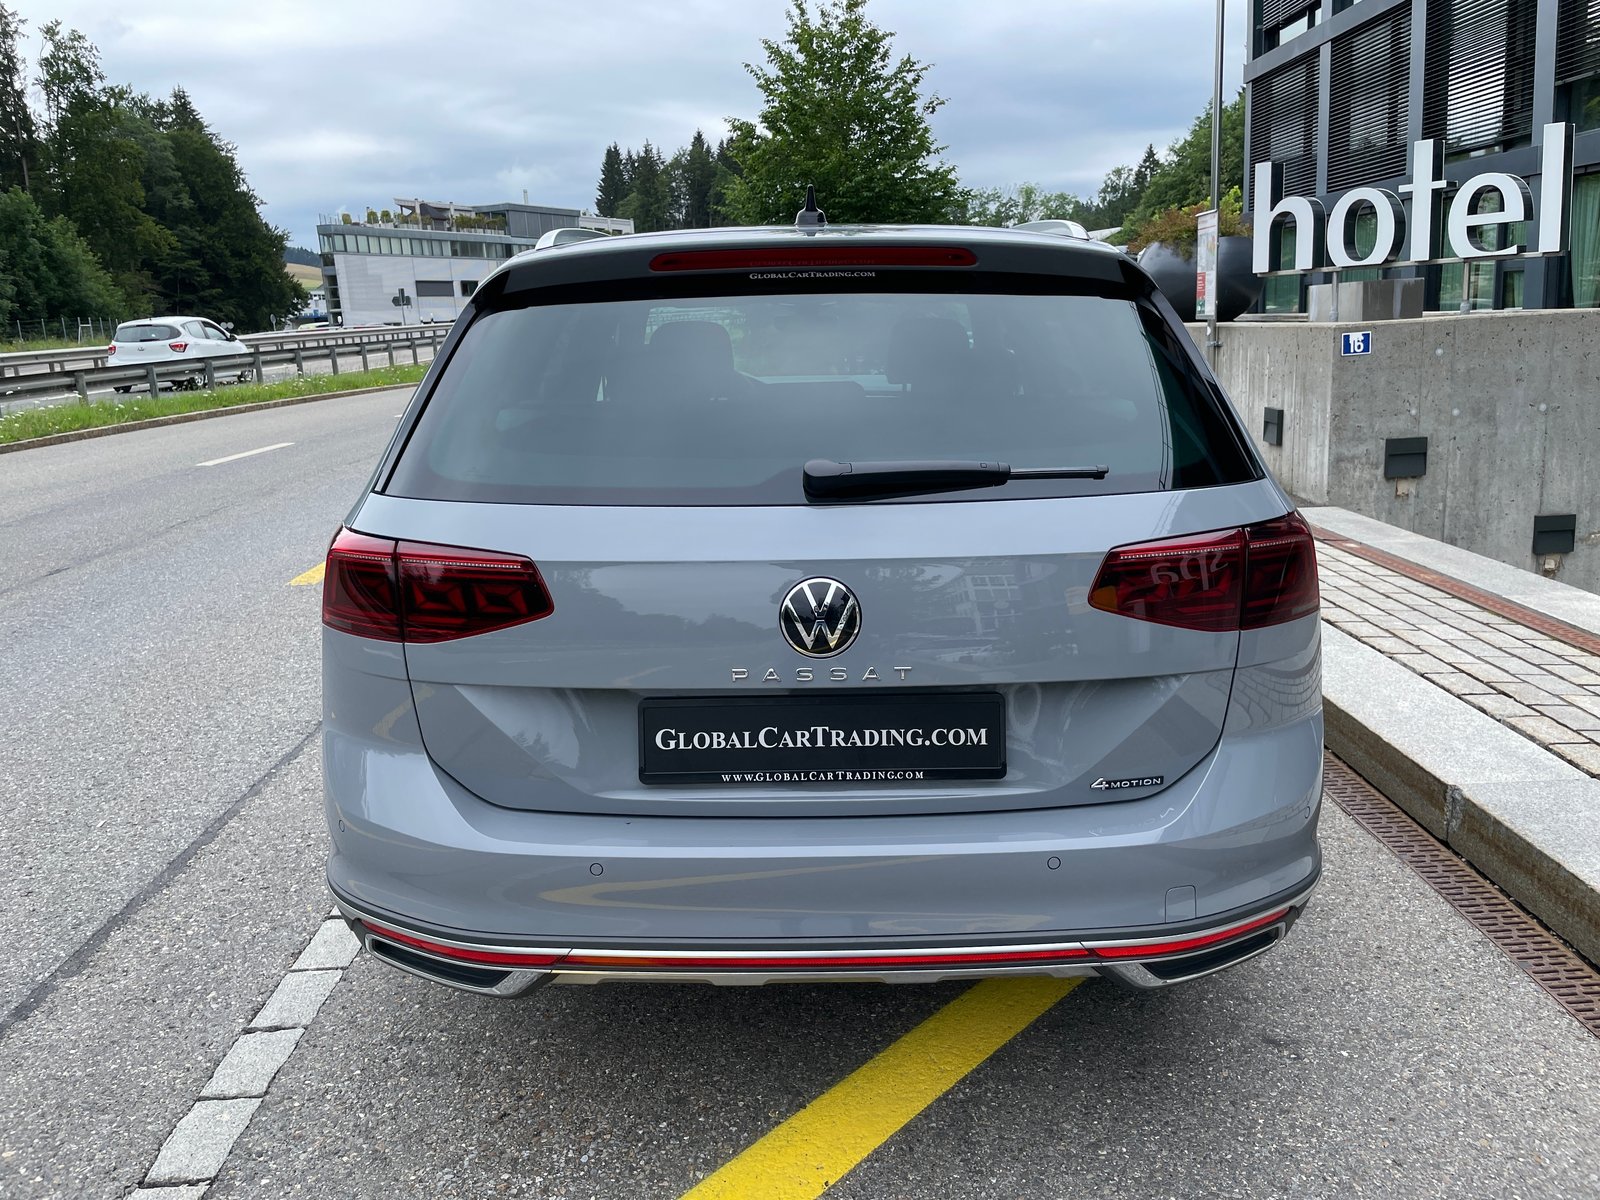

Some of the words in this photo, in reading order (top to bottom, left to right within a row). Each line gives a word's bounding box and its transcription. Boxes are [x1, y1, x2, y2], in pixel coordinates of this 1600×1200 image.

[1252, 122, 1575, 274] hotel
[731, 666, 912, 682] PASSAT
[1090, 777, 1161, 791] 4MOTION
